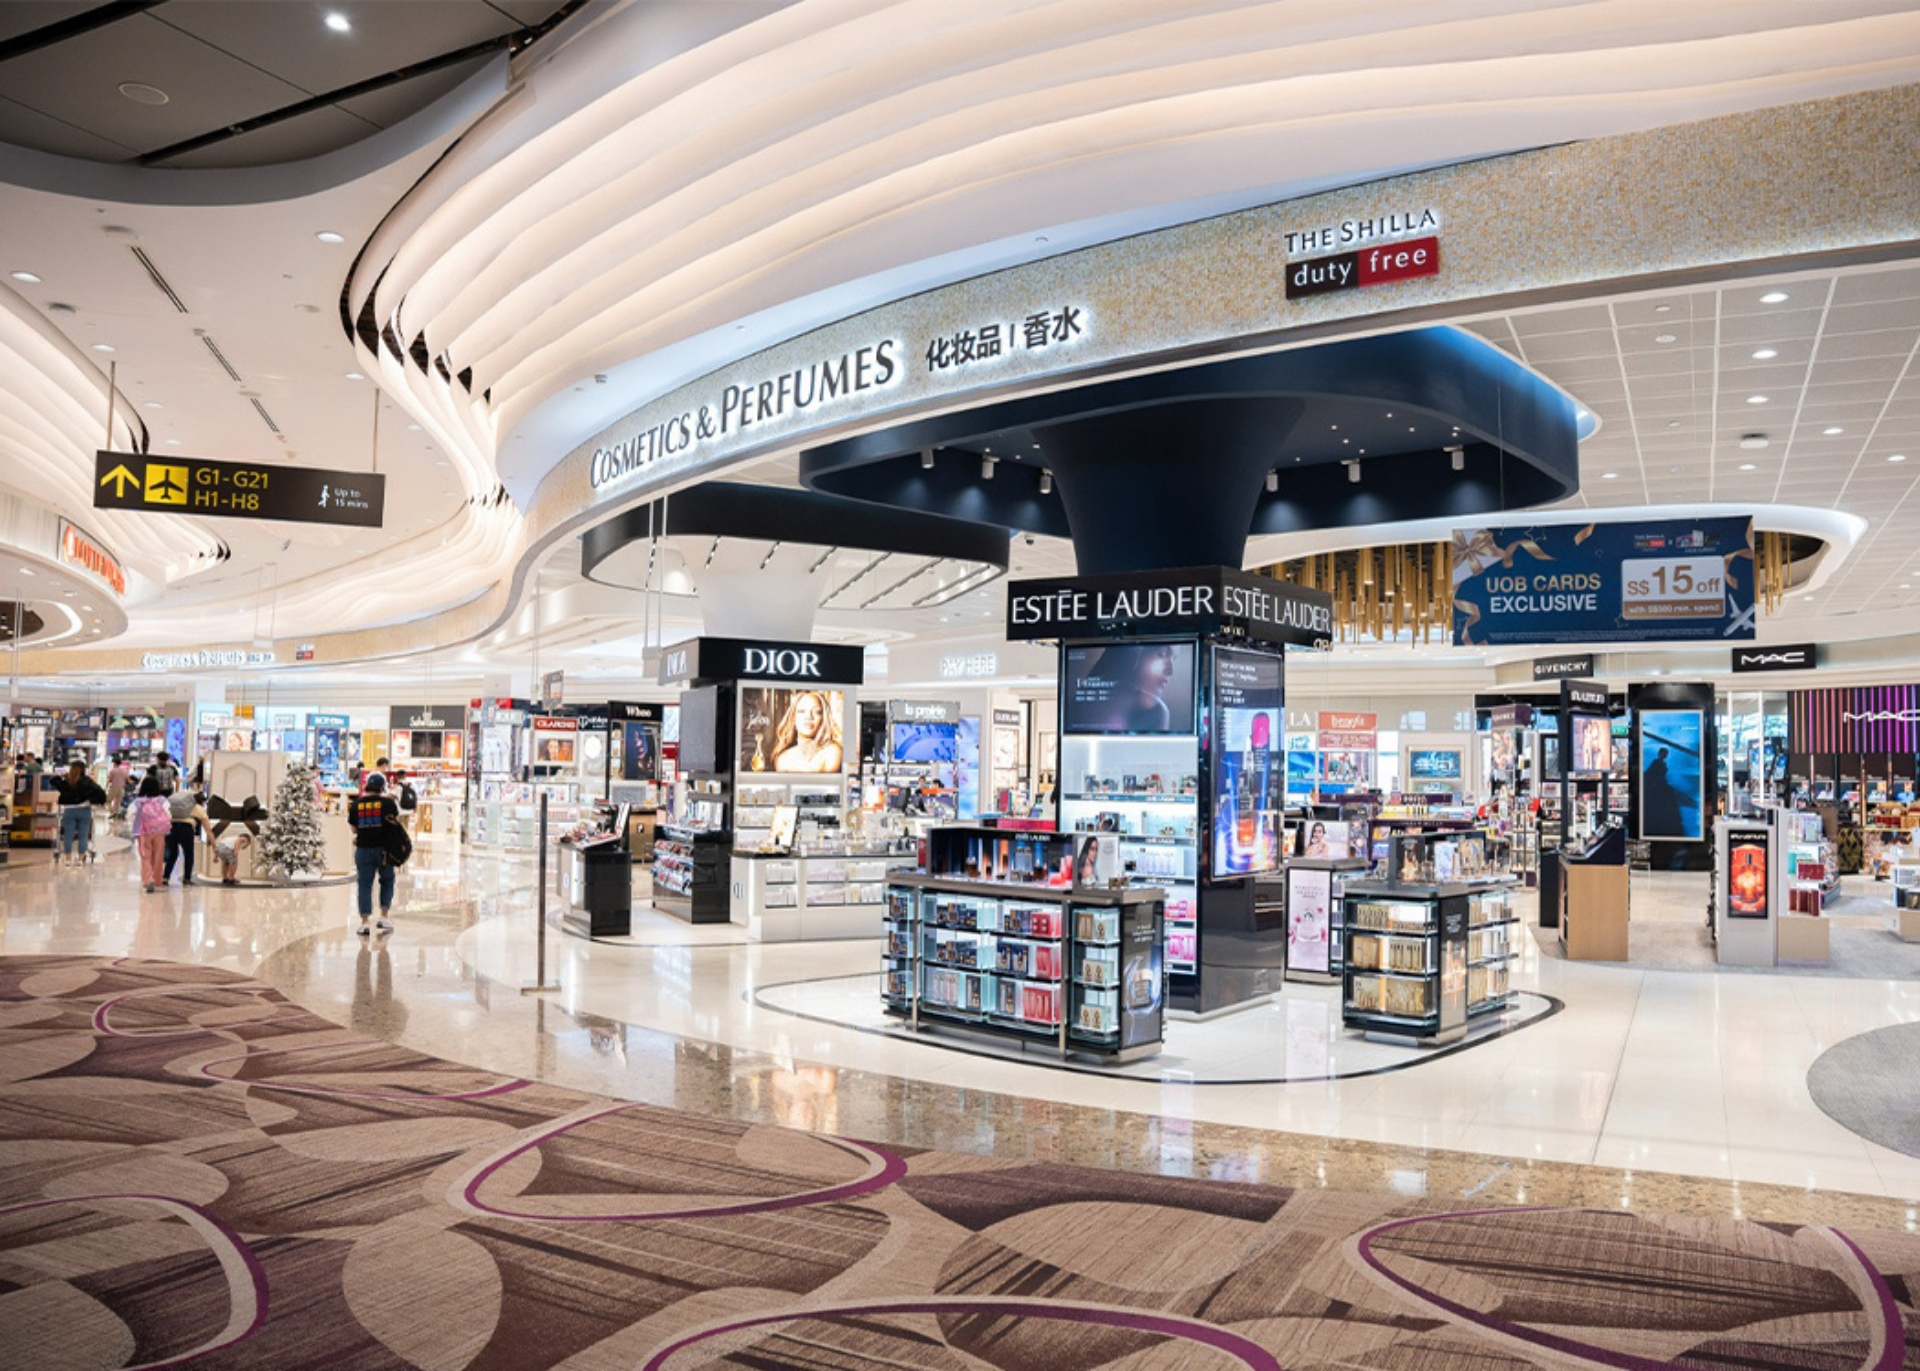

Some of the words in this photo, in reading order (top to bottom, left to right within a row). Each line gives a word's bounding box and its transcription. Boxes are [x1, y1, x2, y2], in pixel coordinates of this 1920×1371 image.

[1284, 228, 1333, 252] THE
[1340, 208, 1436, 242] SHILLA
[1293, 261, 1353, 286] duty
[1369, 248, 1427, 273] free
[926, 324, 1001, 372] 化妆品
[1024, 306, 1081, 349] 香水
[590, 411, 690, 489] COSMETICS
[696, 405, 717, 440] &
[720, 339, 895, 434] PERFUMES
[334, 487, 348, 497] Up
[350, 488, 361, 498] to
[335, 499, 345, 507] 15
[347, 501, 369, 509] mins
[1486, 575, 1528, 593] UOB
[1533, 572, 1601, 592] CARDS
[1697, 577, 1721, 593] off
[1096, 586, 1214, 620] LAUDER
[1490, 593, 1597, 613] EXCLUSIVE
[1274, 596, 1332, 634] LAUDER
[743, 648, 822, 677] DIOR
[941, 658, 964, 677] PAY
[966, 655, 995, 675] HERE
[1534, 661, 1588, 675] GIVENCHY
[916, 704, 947, 719] prairie
[536, 719, 576, 730] CLARINS
